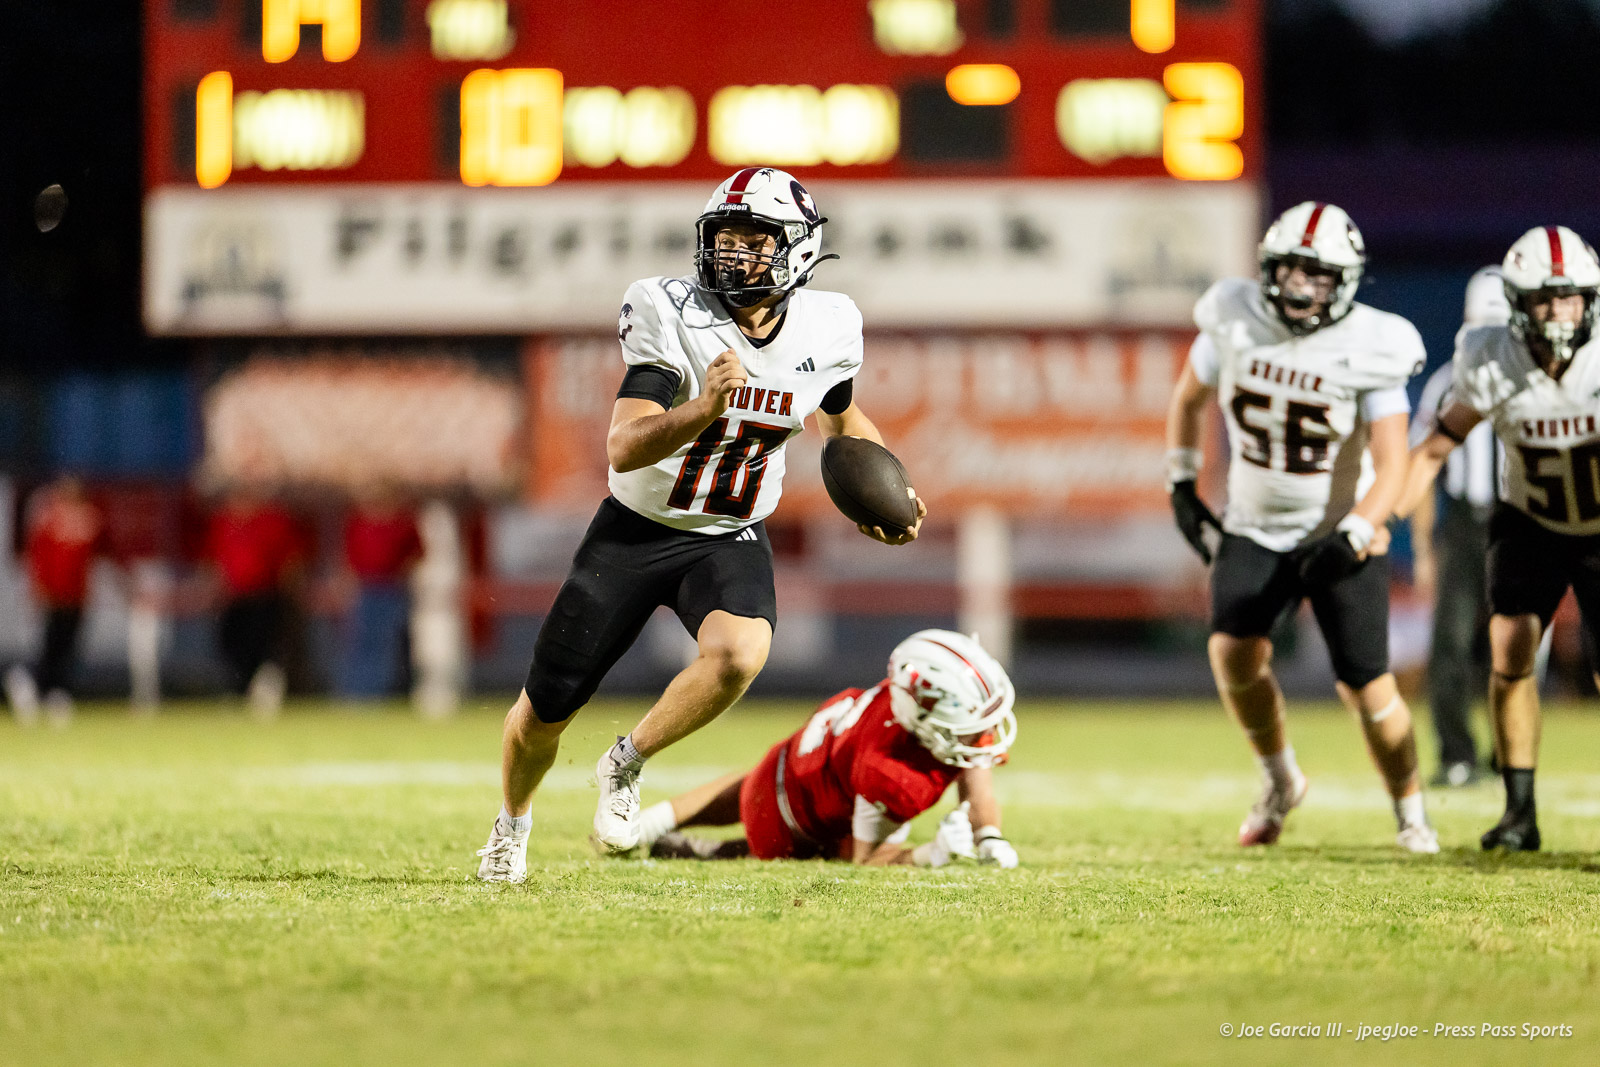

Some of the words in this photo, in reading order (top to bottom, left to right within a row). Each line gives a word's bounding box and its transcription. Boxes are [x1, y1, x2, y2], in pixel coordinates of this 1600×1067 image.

[460, 68, 563, 187] 10
[1163, 62, 1244, 181] 2
[718, 203, 748, 211] Riddell
[729, 385, 793, 416] UVER
[1231, 385, 1331, 476] 56
[667, 416, 793, 519] 10
